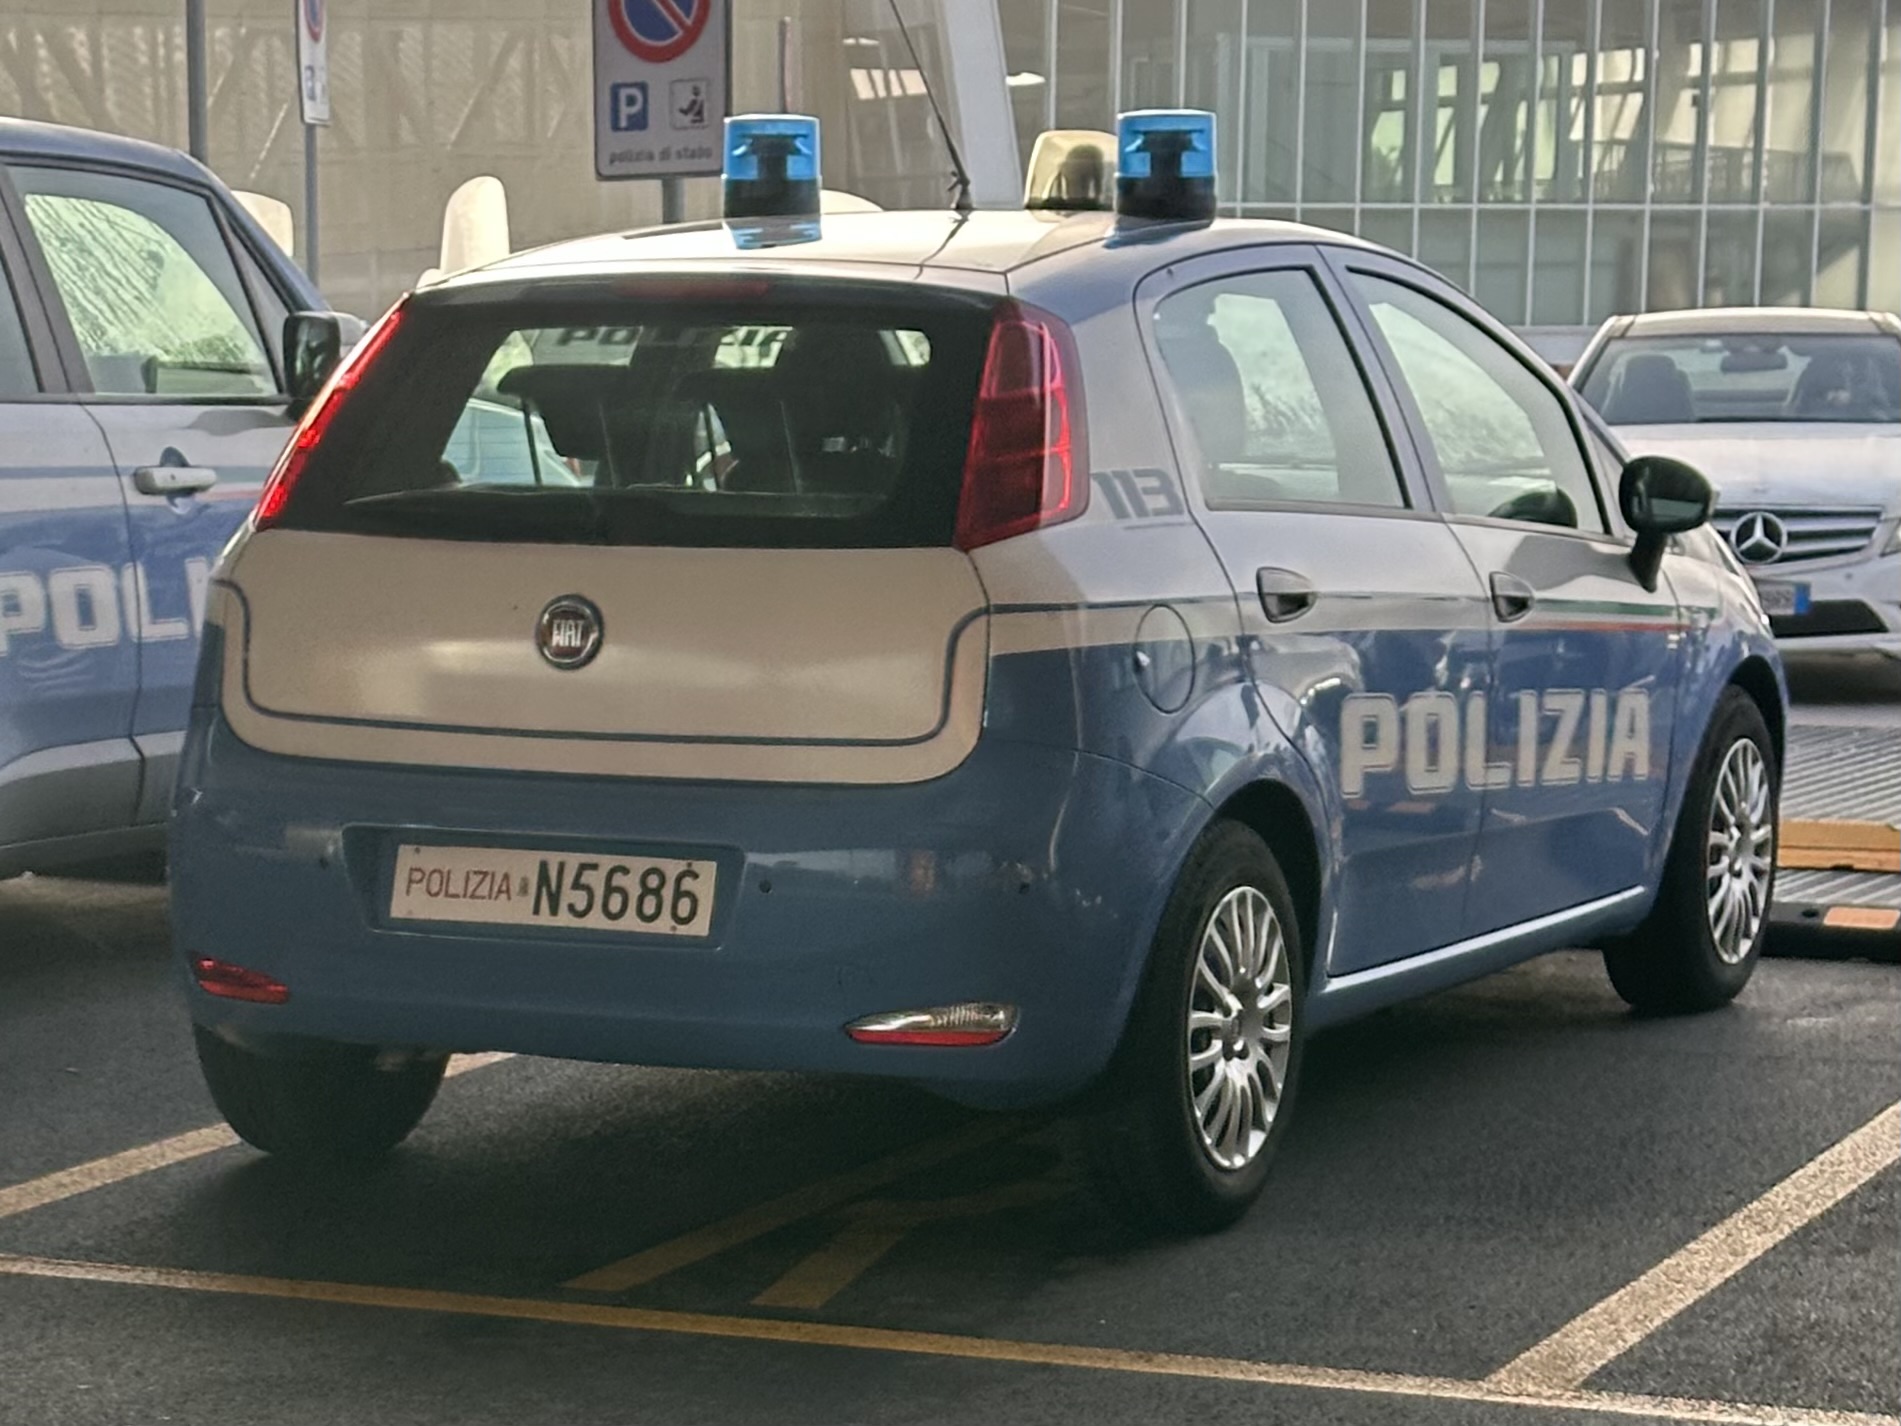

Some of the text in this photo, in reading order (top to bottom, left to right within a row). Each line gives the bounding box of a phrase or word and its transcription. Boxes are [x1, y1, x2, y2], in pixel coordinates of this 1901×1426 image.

[618, 86, 644, 129] P
[1090, 468, 1185, 519] 113
[551, 618, 585, 648] FIAT
[1340, 687, 1650, 799] POLIZIA
[404, 858, 701, 926] POLIZIA N5686
